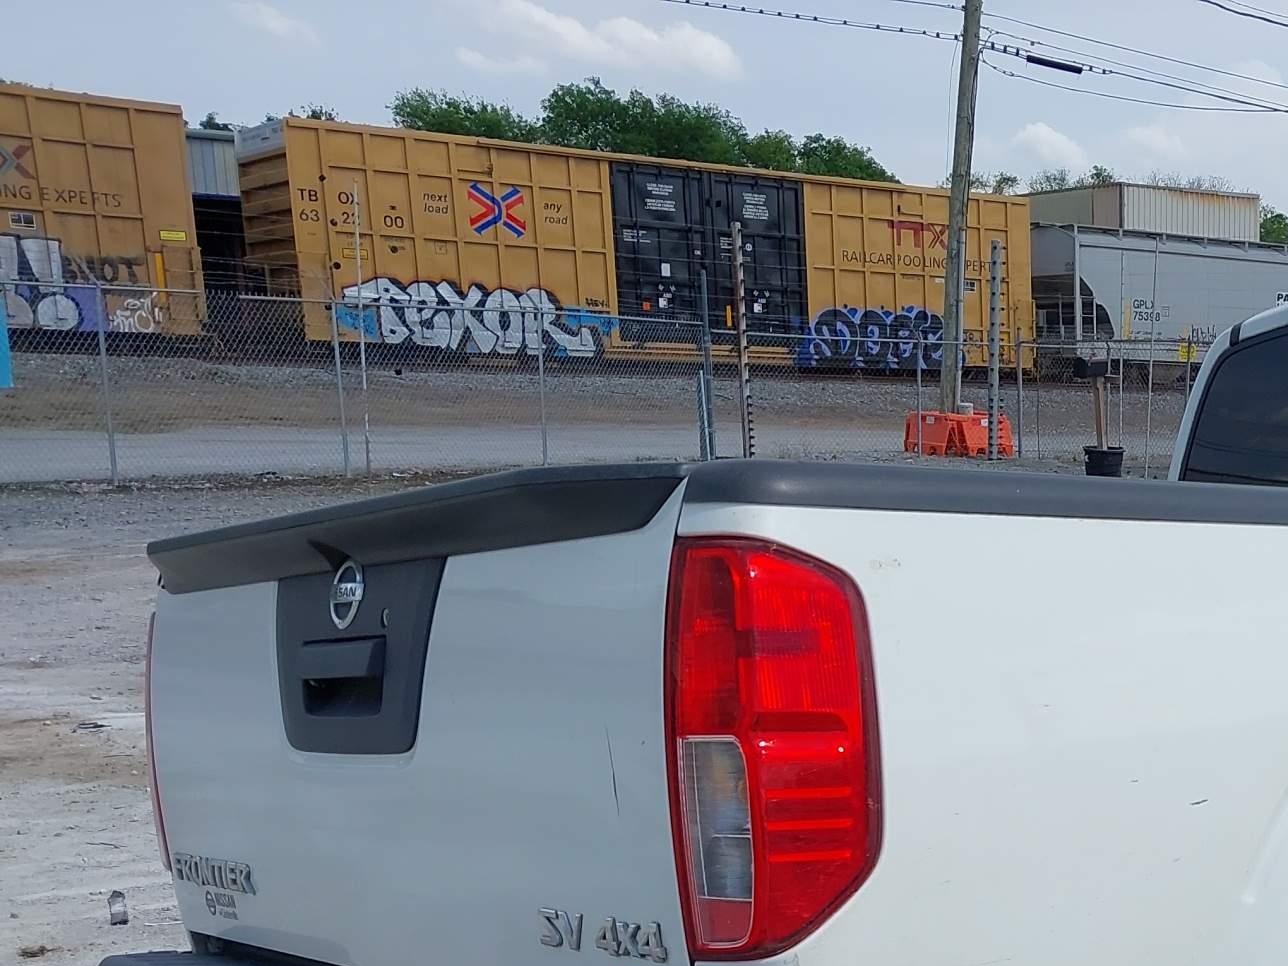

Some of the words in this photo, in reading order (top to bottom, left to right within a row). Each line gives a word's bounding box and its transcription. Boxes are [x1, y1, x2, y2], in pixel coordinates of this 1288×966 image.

[422, 192, 448, 203] next
[423, 203, 449, 214] load
[543, 202, 562, 213] any
[544, 215, 568, 225] road
[842, 250, 892, 266] RAILCAR
[1133, 300, 1154, 310] GPLX
[1133, 311, 1160, 322] 75398
[174, 852, 256, 896] FRONTIER
[539, 907, 583, 952] SV
